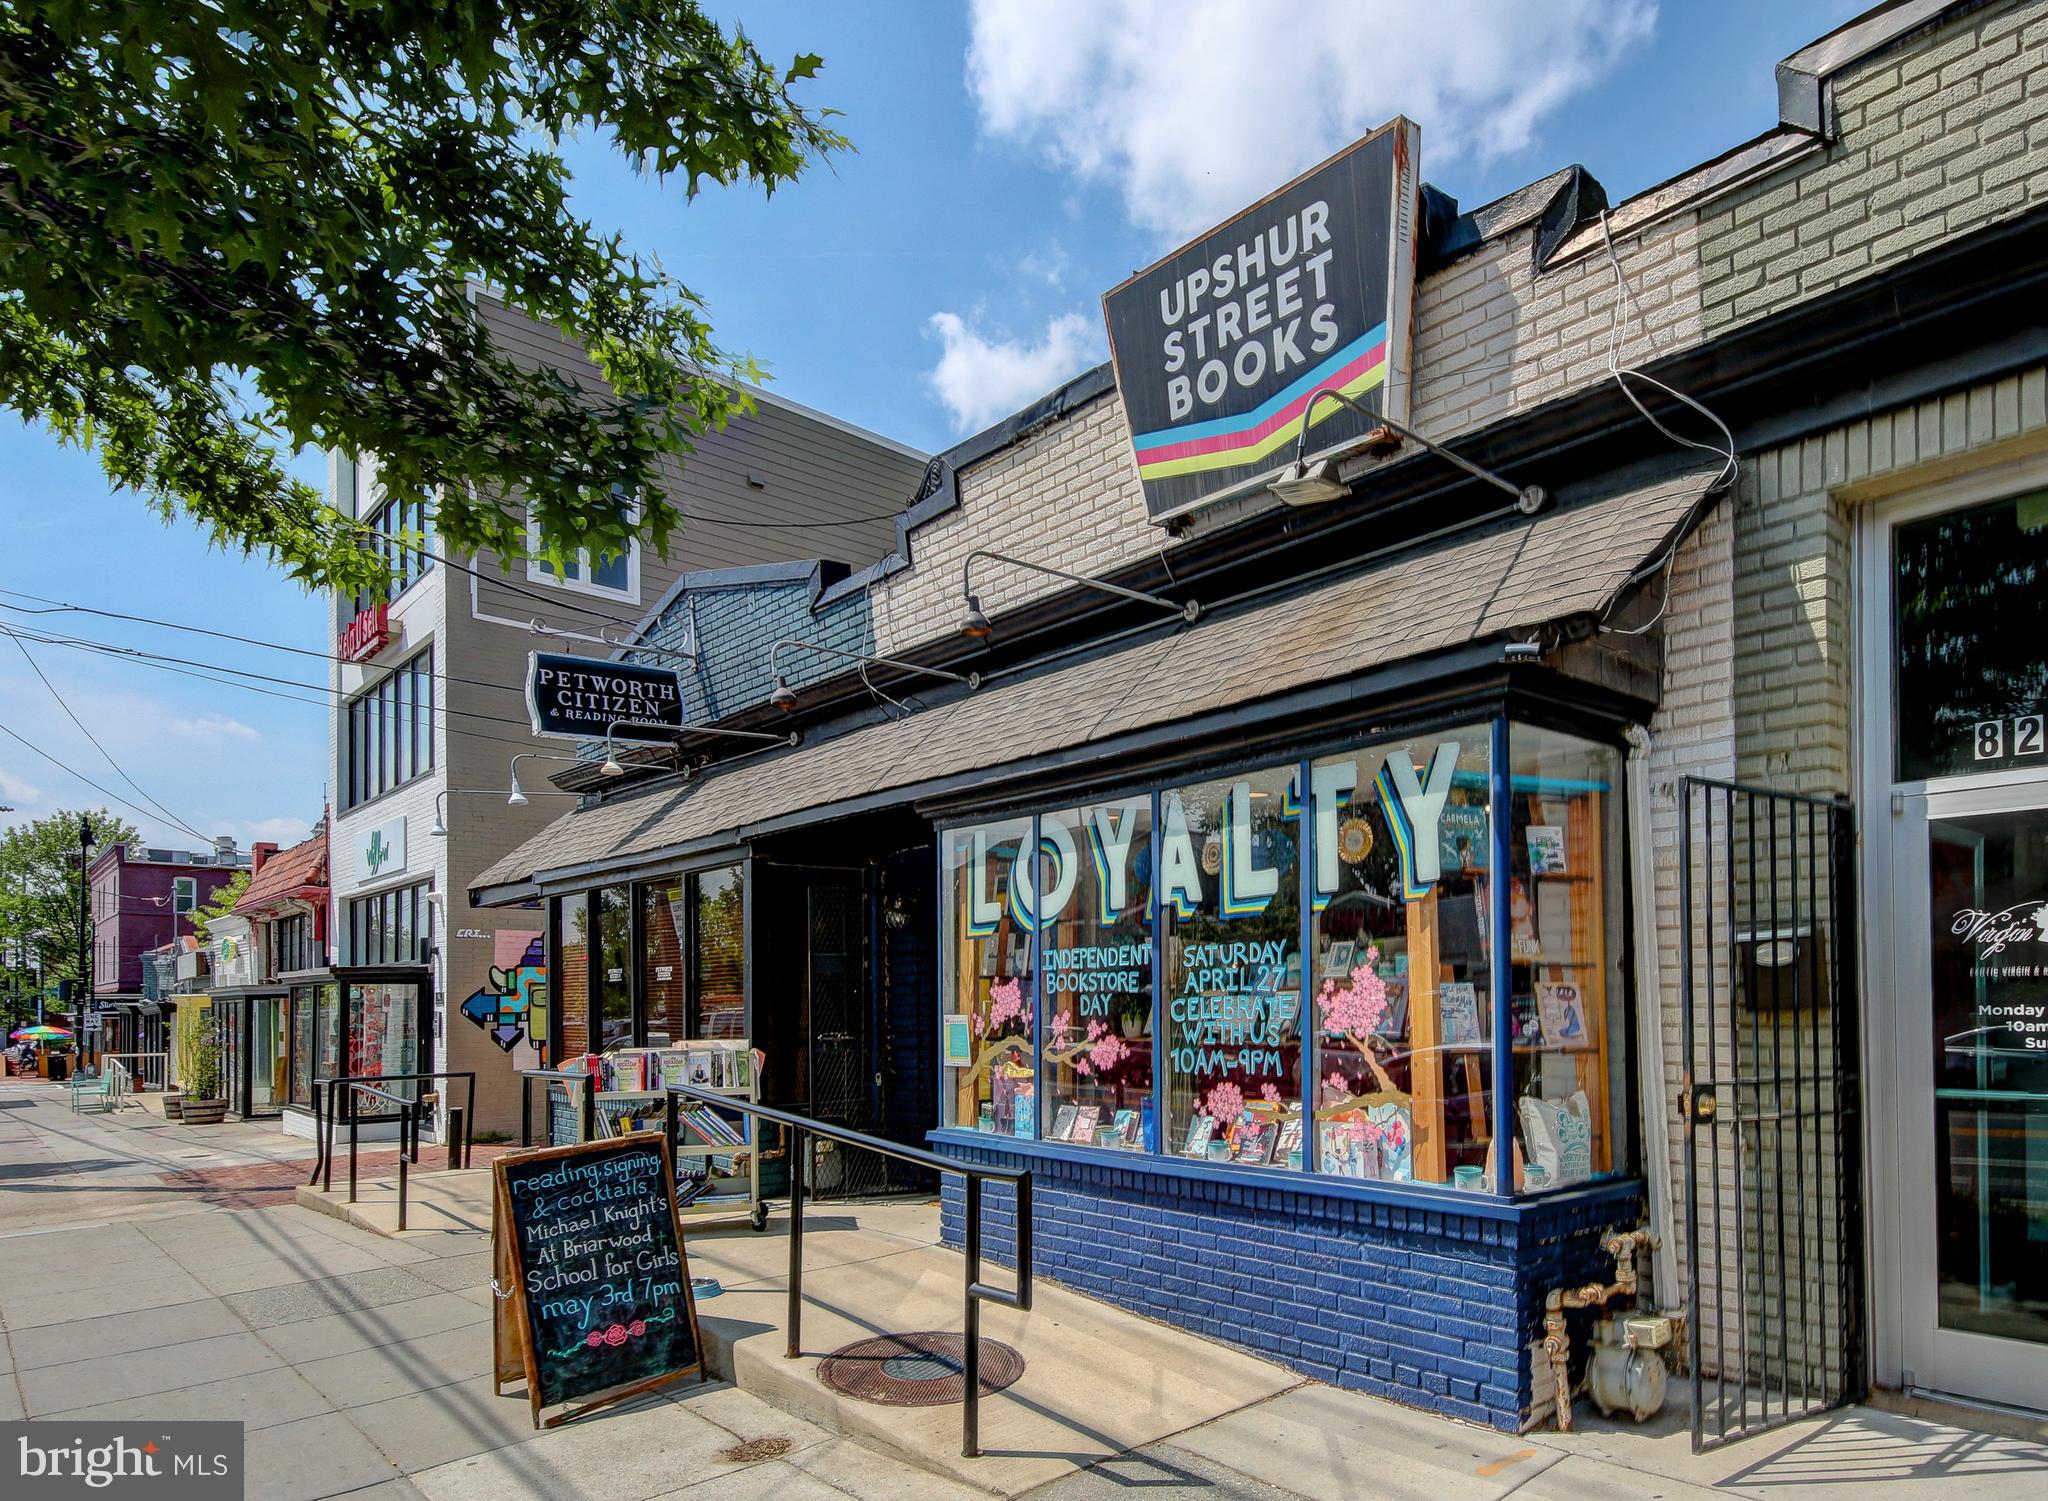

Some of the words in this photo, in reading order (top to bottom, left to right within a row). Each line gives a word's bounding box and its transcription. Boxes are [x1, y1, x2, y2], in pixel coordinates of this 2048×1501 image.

[1160, 200, 1330, 326] UPSHUR
[1164, 249, 1333, 373] STREET
[1167, 303, 1339, 422] BOOKS
[539, 668, 675, 700] PETWORTH
[550, 708, 560, 717] &
[565, 709, 625, 723] READING
[557, 690, 660, 716] CITIZEN
[967, 742, 1460, 939] LOYALTY
[1951, 900, 2045, 960] Virgin
[1042, 943, 1152, 971] INDEPENDENT
[1182, 938, 1288, 969] SATURDAY
[1046, 971, 1139, 994] BOOKSTORE
[1184, 966, 1253, 994] APRIL
[1256, 965, 1288, 992] 27
[1080, 993, 1112, 1017] DAY
[1170, 995, 1297, 1023] CELEBRATE
[1978, 1004, 2045, 1018] Monday
[1181, 1020, 1244, 1047] WITH
[1250, 1020, 1281, 1047] US
[1170, 1048, 1284, 1077] 10AM-9PM
[532, 1197, 551, 1219] &
[557, 1178, 648, 1211] cocktails
[526, 1210, 598, 1243] Michael
[603, 1197, 668, 1231] Knight's
[537, 1246, 558, 1265] At
[562, 1224, 655, 1259] Briarwood
[527, 1258, 599, 1293] School
[604, 1253, 633, 1278] for
[636, 1245, 680, 1271] Girls
[541, 1294, 595, 1329] may
[600, 1276, 635, 1305] 3rd
[639, 1275, 681, 1307] 7pm
